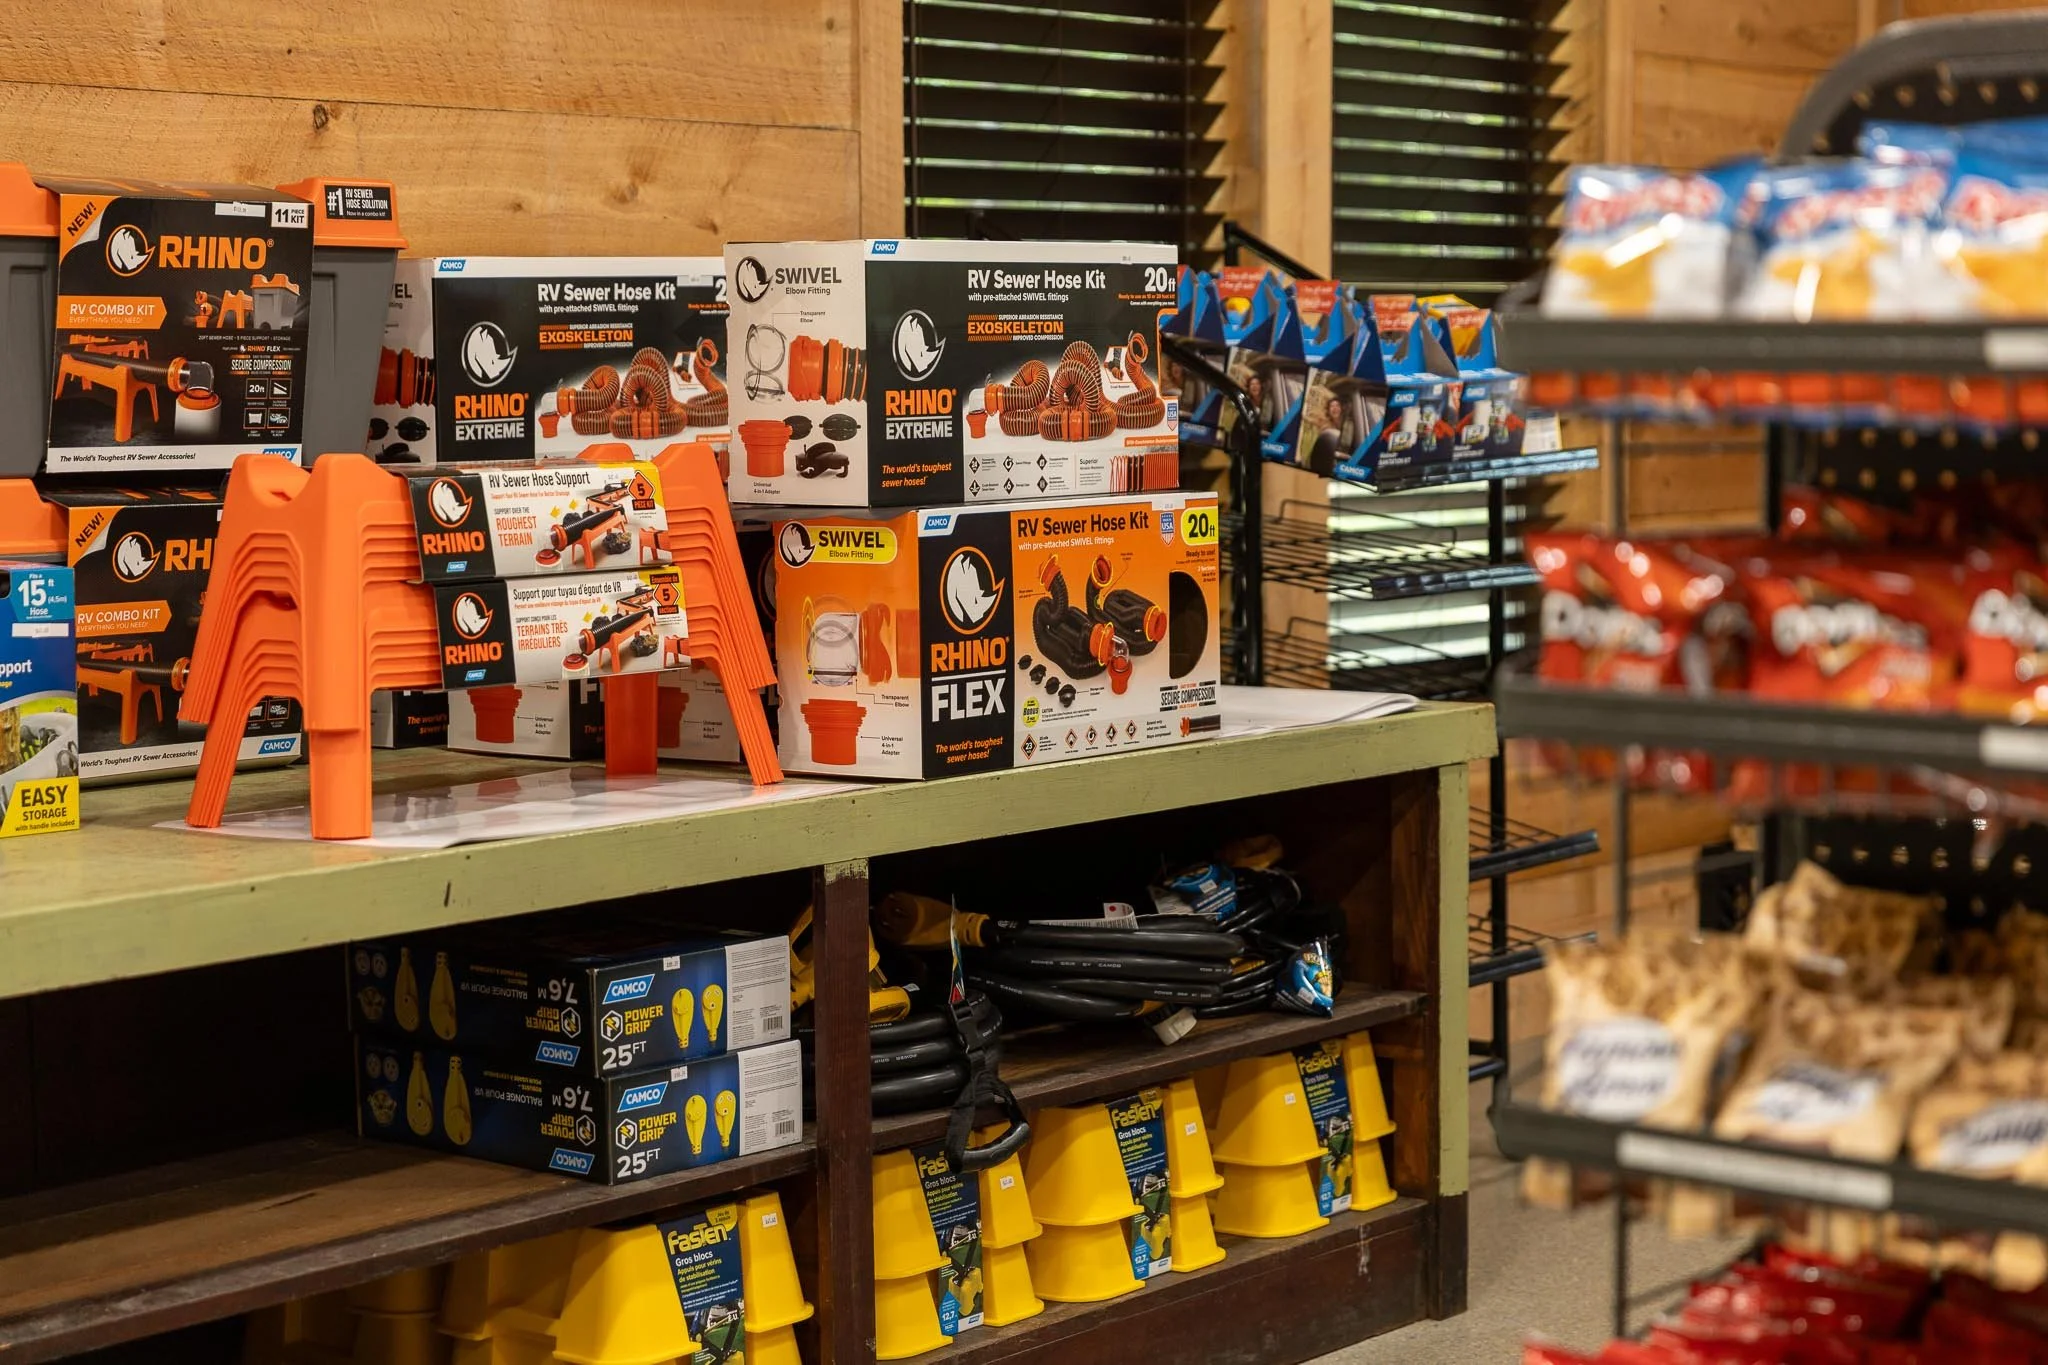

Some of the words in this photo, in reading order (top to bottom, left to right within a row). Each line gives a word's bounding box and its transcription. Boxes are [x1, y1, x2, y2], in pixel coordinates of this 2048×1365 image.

[345, 188, 353, 198] RV
[353, 189, 373, 199] SEWER
[327, 188, 344, 216] #1
[345, 199, 361, 209] HOSE
[361, 200, 388, 210] SOLUTION
[66, 201, 97, 236] NEW!
[274, 208, 289, 223] 11
[290, 215, 304, 224] KIT
[874, 243, 896, 252] CAMCO
[441, 261, 463, 270] CAMCO
[775, 266, 842, 285] SWIVEL
[967, 269, 991, 289] RV
[993, 269, 1041, 290] Sewer
[1044, 270, 1082, 290] Hose
[1085, 269, 1107, 290] Kit
[538, 283, 560, 302] RV
[563, 283, 611, 301] Sewer
[614, 282, 652, 301] Hose
[655, 281, 677, 300] Kit
[785, 287, 806, 295] Elbow
[807, 287, 831, 296] Fitting
[69, 303, 87, 315] RV
[88, 304, 134, 316] COMBO
[136, 304, 155, 316] KIT
[539, 305, 553, 313] with
[553, 304, 592, 314] pre-attached
[592, 303, 617, 312] SWIVEL
[617, 303, 639, 313] fittings
[967, 321, 1064, 335] EXOSKELETON
[539, 330, 634, 343] EXOSKELETON
[455, 422, 526, 441] EXTREME
[886, 420, 953, 440] EXTREME
[72, 454, 97, 462] World's
[97, 454, 126, 463] Toughest
[137, 453, 157, 461] Sewer
[157, 452, 197, 461] Accessories!
[882, 464, 895, 475] The
[896, 463, 921, 474] world's
[921, 462, 952, 474] toughest
[489, 474, 502, 489] RV
[502, 473, 532, 489] Sewer
[532, 472, 555, 487] Hose
[555, 471, 591, 488] Support
[75, 512, 105, 547] NEW!
[496, 516, 537, 531] ROUGHEST
[927, 518, 948, 527] CAMCO
[1017, 518, 1039, 538] RV
[1042, 517, 1087, 535] Sewer
[1090, 513, 1126, 533] Hose
[1129, 511, 1149, 530] Kit
[1161, 522, 1174, 531] USA
[498, 532, 533, 548] TERRAIN
[818, 530, 885, 549] SWIVEL
[1018, 543, 1032, 551] with
[1032, 540, 1070, 550] pre-attached
[1070, 538, 1094, 547] SWIVEL
[1094, 536, 1115, 546] fittings
[829, 550, 850, 558] Elbow
[850, 550, 874, 560] Fitting
[18, 579, 47, 607] 15
[513, 588, 540, 602] Support
[541, 588, 558, 602] pour
[558, 587, 578, 600] tuyau
[578, 584, 603, 597] d'égout
[603, 584, 612, 594] de
[612, 581, 622, 592] VR
[30, 607, 49, 616] Hose
[77, 612, 94, 625] RV
[96, 609, 139, 623] COMBO
[142, 608, 161, 621] KIT
[517, 623, 551, 637] TERRAINS
[551, 620, 568, 635] TRÈS
[518, 636, 562, 651] IRRÉGULIERS
[931, 678, 1006, 723] FLEX
[1160, 690, 1181, 706] SECURE
[1181, 686, 1216, 704] COMPRESSION
[263, 740, 292, 751] CAMCO
[935, 745, 949, 754] The
[949, 740, 974, 752] world's
[974, 736, 1003, 749] toughest
[946, 755, 967, 764] sewer
[967, 750, 991, 761] hoses!
[21, 784, 68, 808] EASY
[23, 807, 67, 822] STORAGE
[15, 824, 28, 832] with
[29, 822, 50, 831] handle
[50, 819, 76, 828] included
[611, 980, 647, 997] CAMCO
[536, 1006, 559, 1020] GRIP
[624, 1005, 664, 1023] POWER
[525, 1016, 561, 1033] POWER
[625, 1020, 652, 1036] GRIP
[542, 1046, 573, 1061] CAMCO
[474, 1087, 485, 1096] VR
[485, 1088, 505, 1101] POUR
[506, 1092, 543, 1107] RALLONGE
[626, 1088, 661, 1105] CAMCO
[551, 1113, 574, 1127] GRIP
[638, 1111, 677, 1131] POWER
[540, 1123, 575, 1140] POWER
[639, 1127, 666, 1144] GRIP
[1118, 1130, 1132, 1140] Gros
[1131, 1125, 1147, 1137] blocs
[556, 1153, 588, 1169] CAMCO
[925, 1178, 940, 1190] Gros
[939, 1174, 957, 1187] blocs
[675, 1256, 694, 1268] Gros
[693, 1250, 714, 1263] blocs
[677, 1265, 696, 1276] Appuis
[695, 1261, 707, 1271] pour
[706, 1257, 723, 1268] vérins
[678, 1276, 687, 1284] de
[686, 1268, 716, 1281] stabilisation
